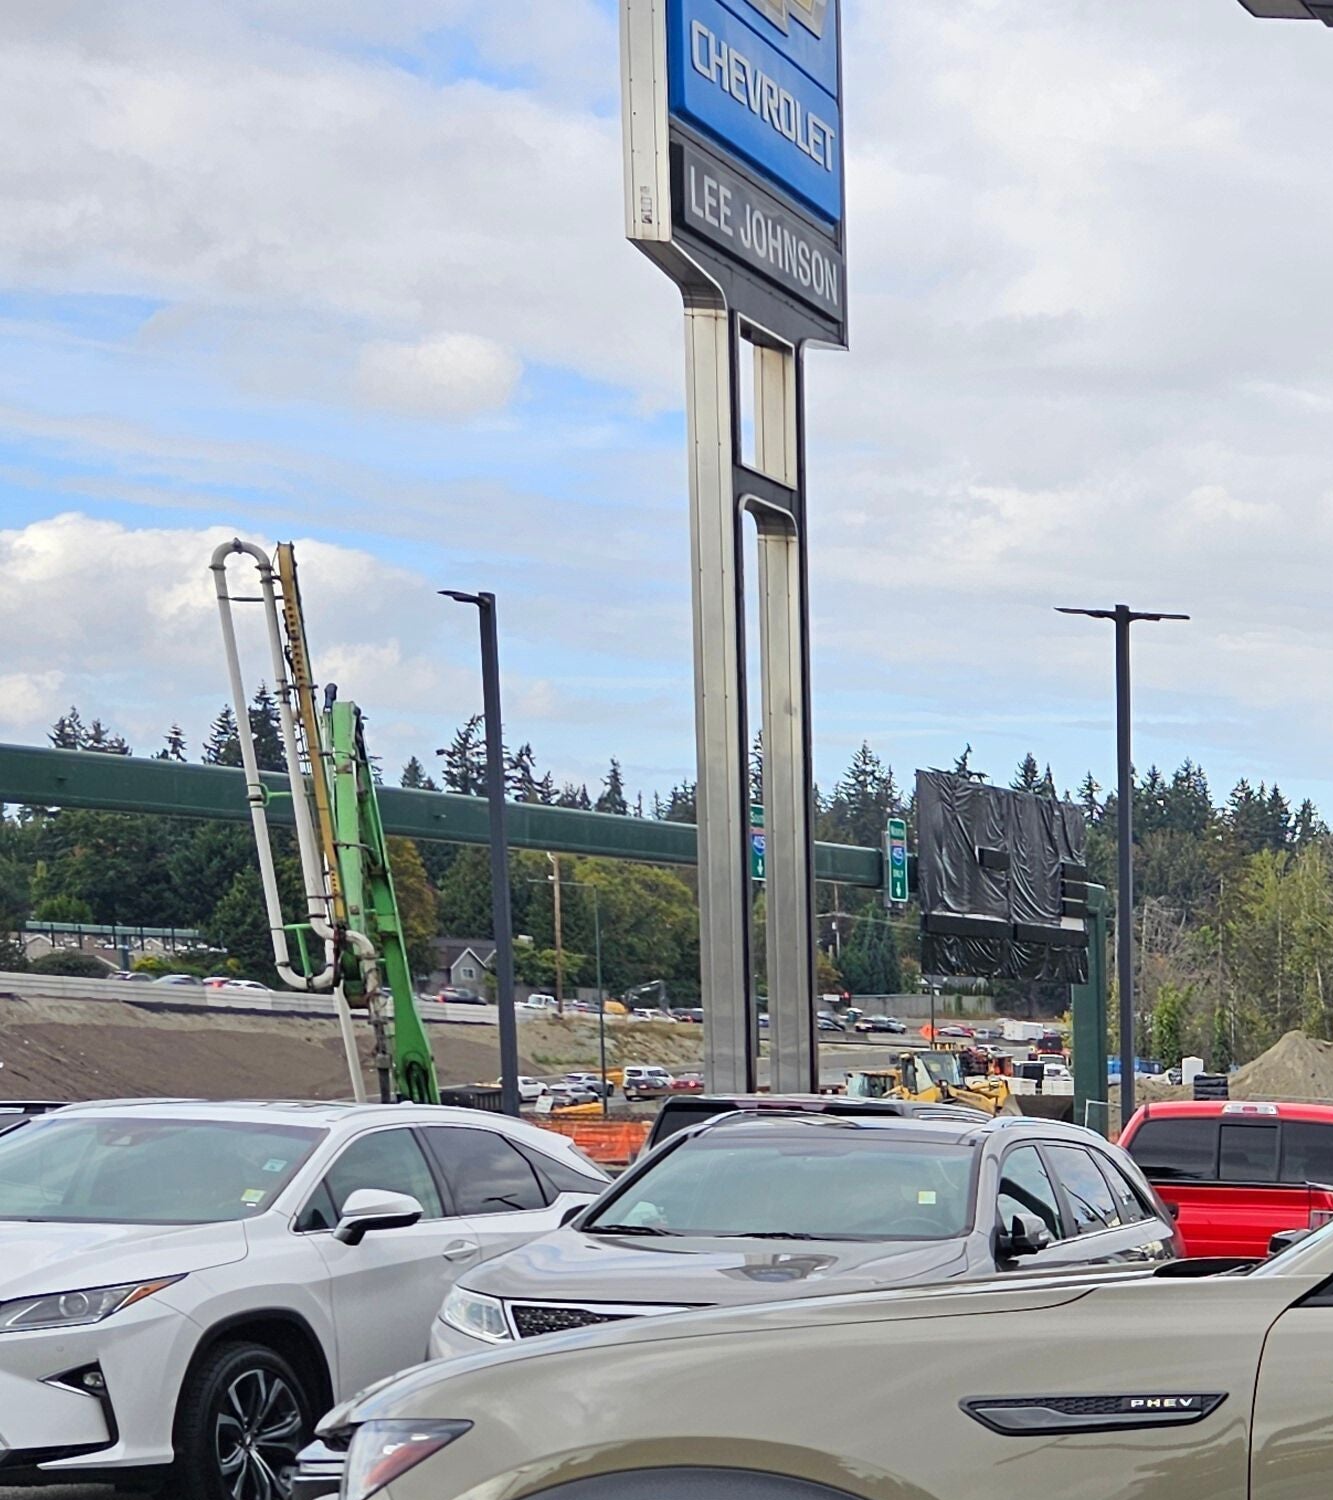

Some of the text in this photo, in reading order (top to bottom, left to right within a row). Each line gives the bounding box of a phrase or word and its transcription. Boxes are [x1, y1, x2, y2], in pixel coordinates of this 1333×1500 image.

[691, 19, 835, 172] CHEVROLET
[690, 165, 838, 305] LEE JOHNSON
[1130, 1397, 1193, 1408] PHEV
